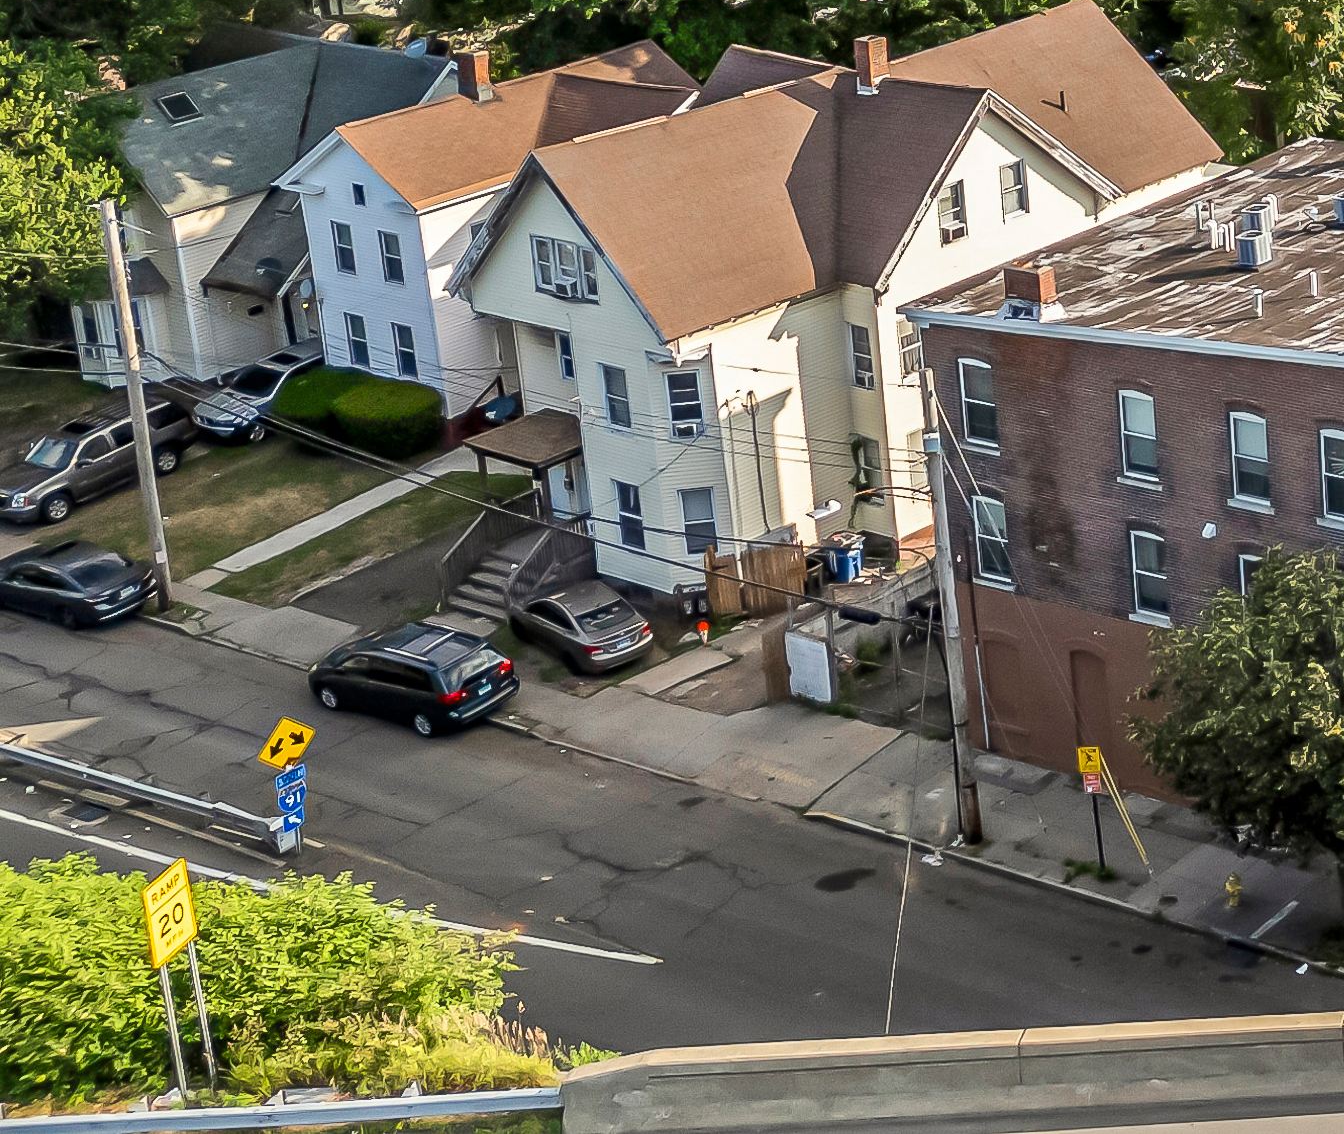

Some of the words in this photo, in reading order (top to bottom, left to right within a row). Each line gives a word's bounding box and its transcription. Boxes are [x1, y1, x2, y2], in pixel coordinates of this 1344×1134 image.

[285, 791, 301, 807] 91
[151, 873, 180, 905] RAMP
[158, 902, 184, 939] 20
